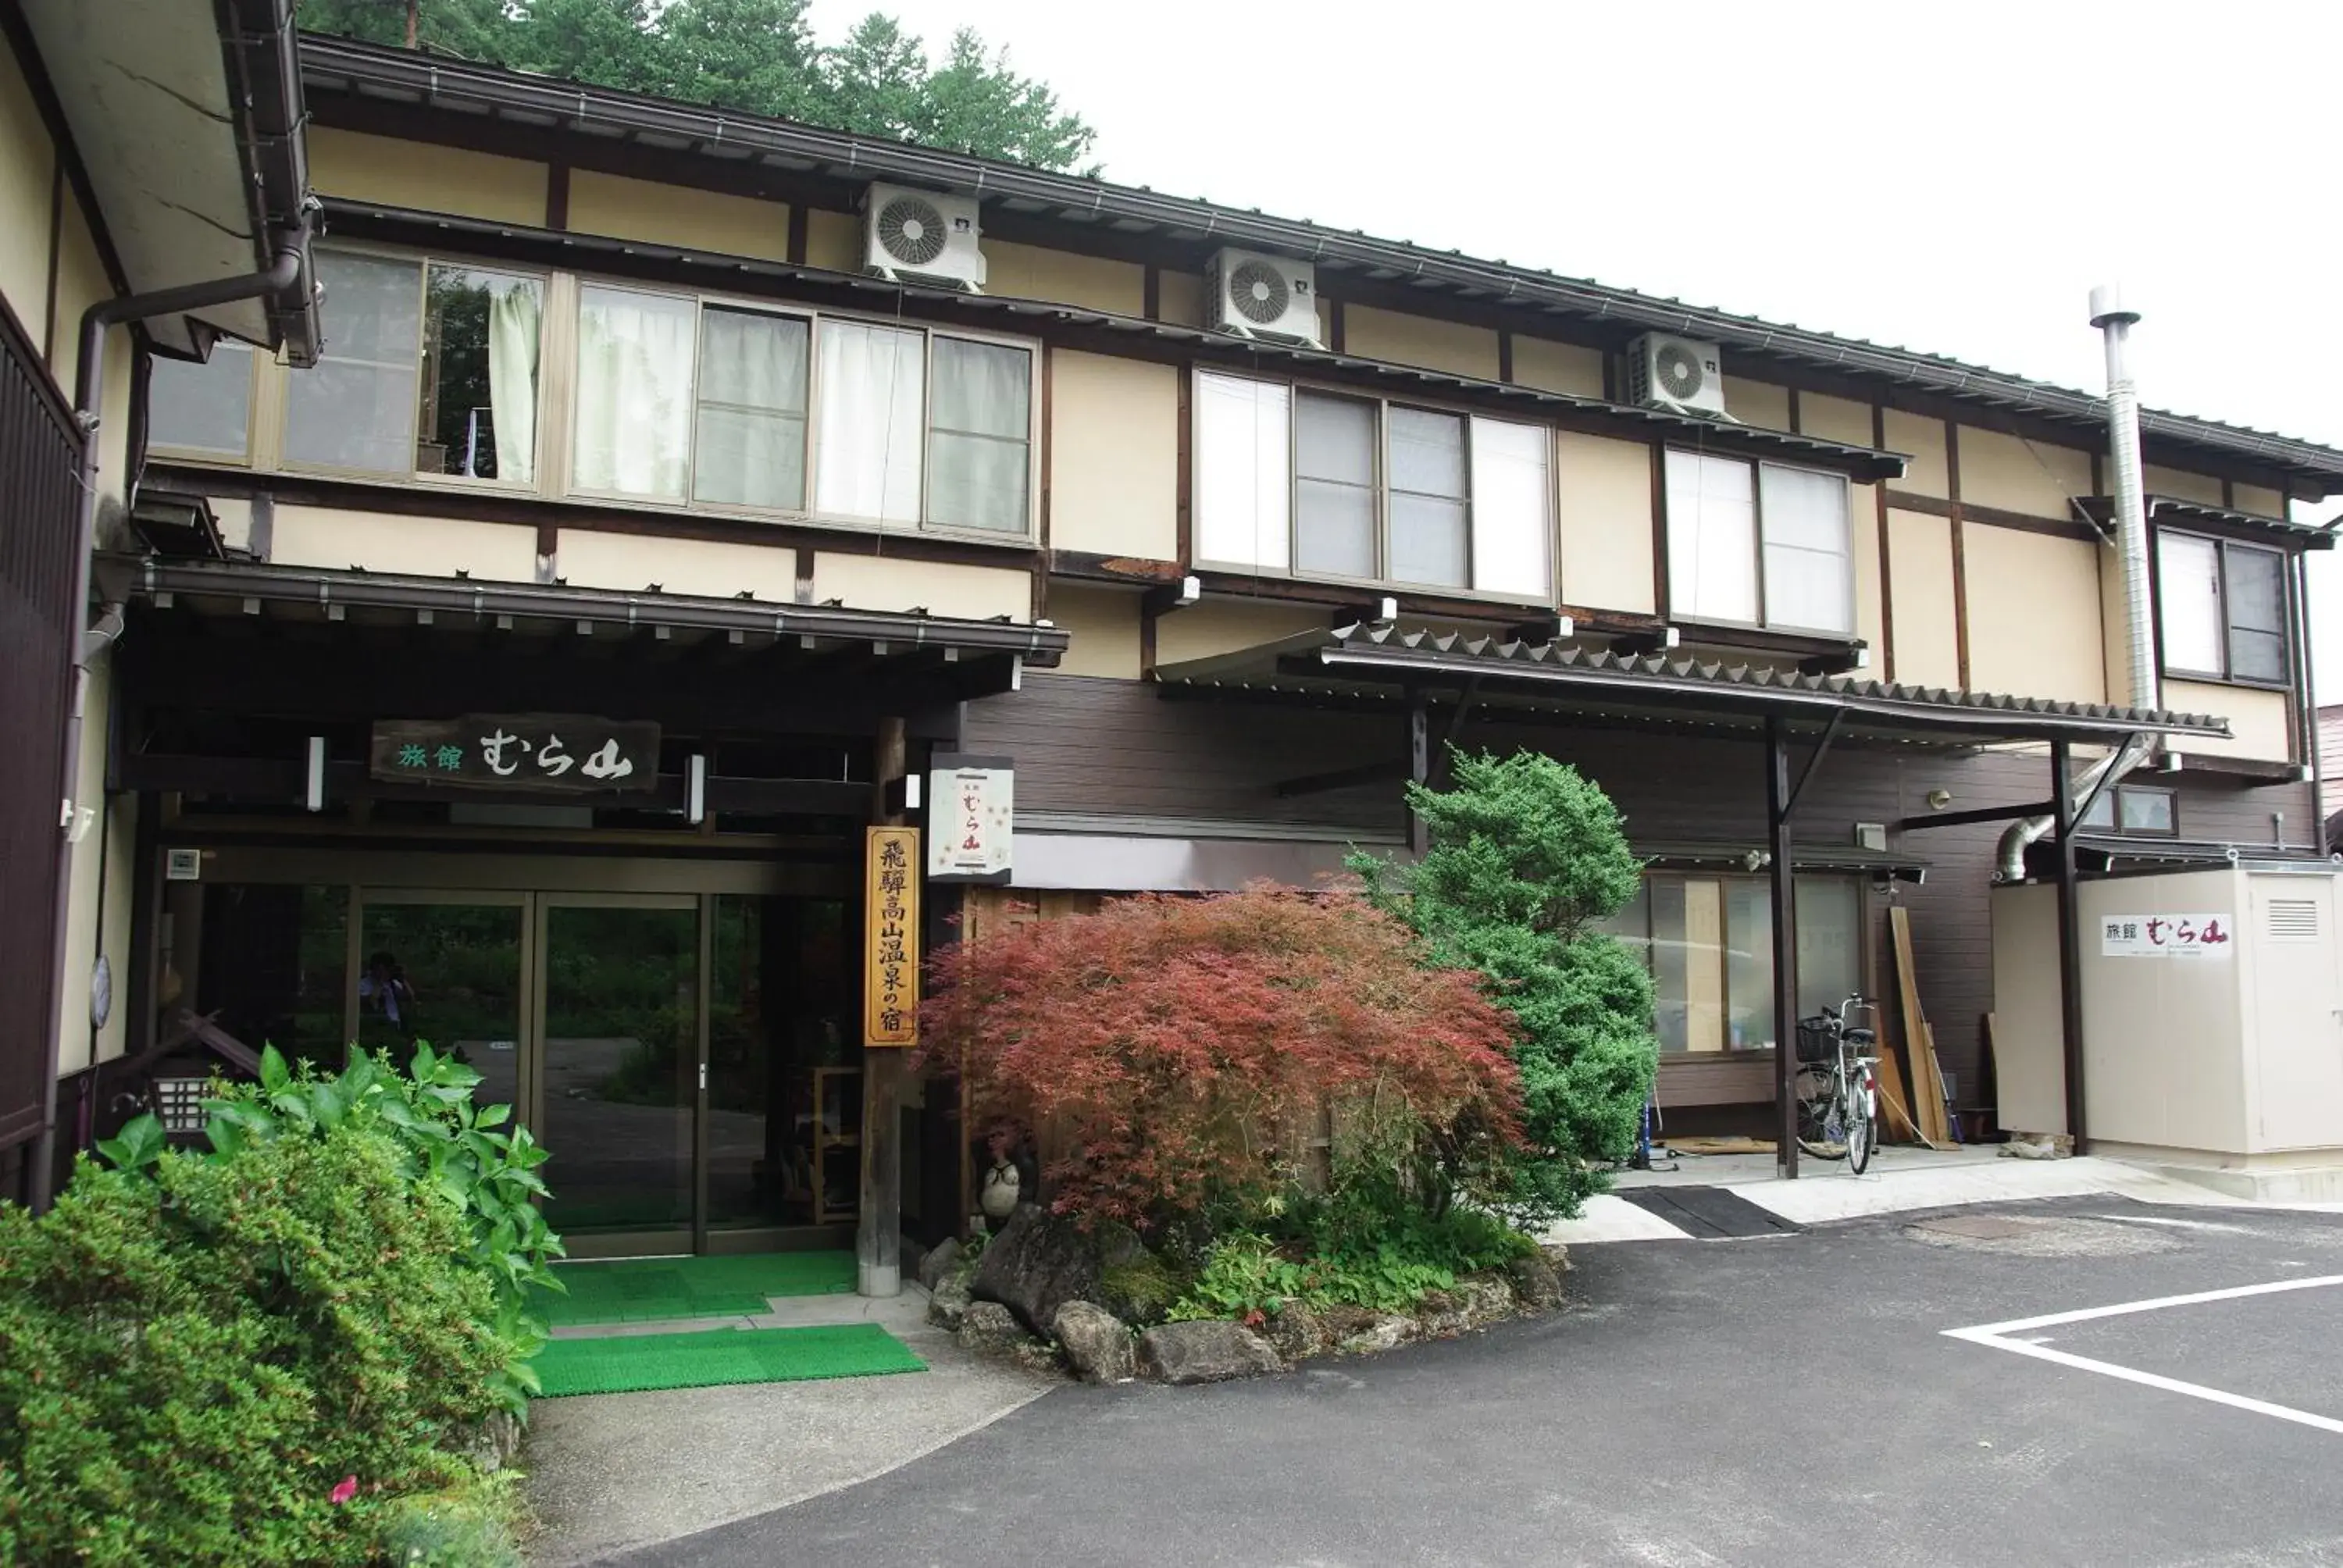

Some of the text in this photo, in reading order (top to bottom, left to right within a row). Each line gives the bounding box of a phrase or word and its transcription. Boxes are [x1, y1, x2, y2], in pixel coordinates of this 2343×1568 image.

[398, 728, 633, 779] 旅館 むら山
[2106, 917, 2228, 946] 旅館 むら山
